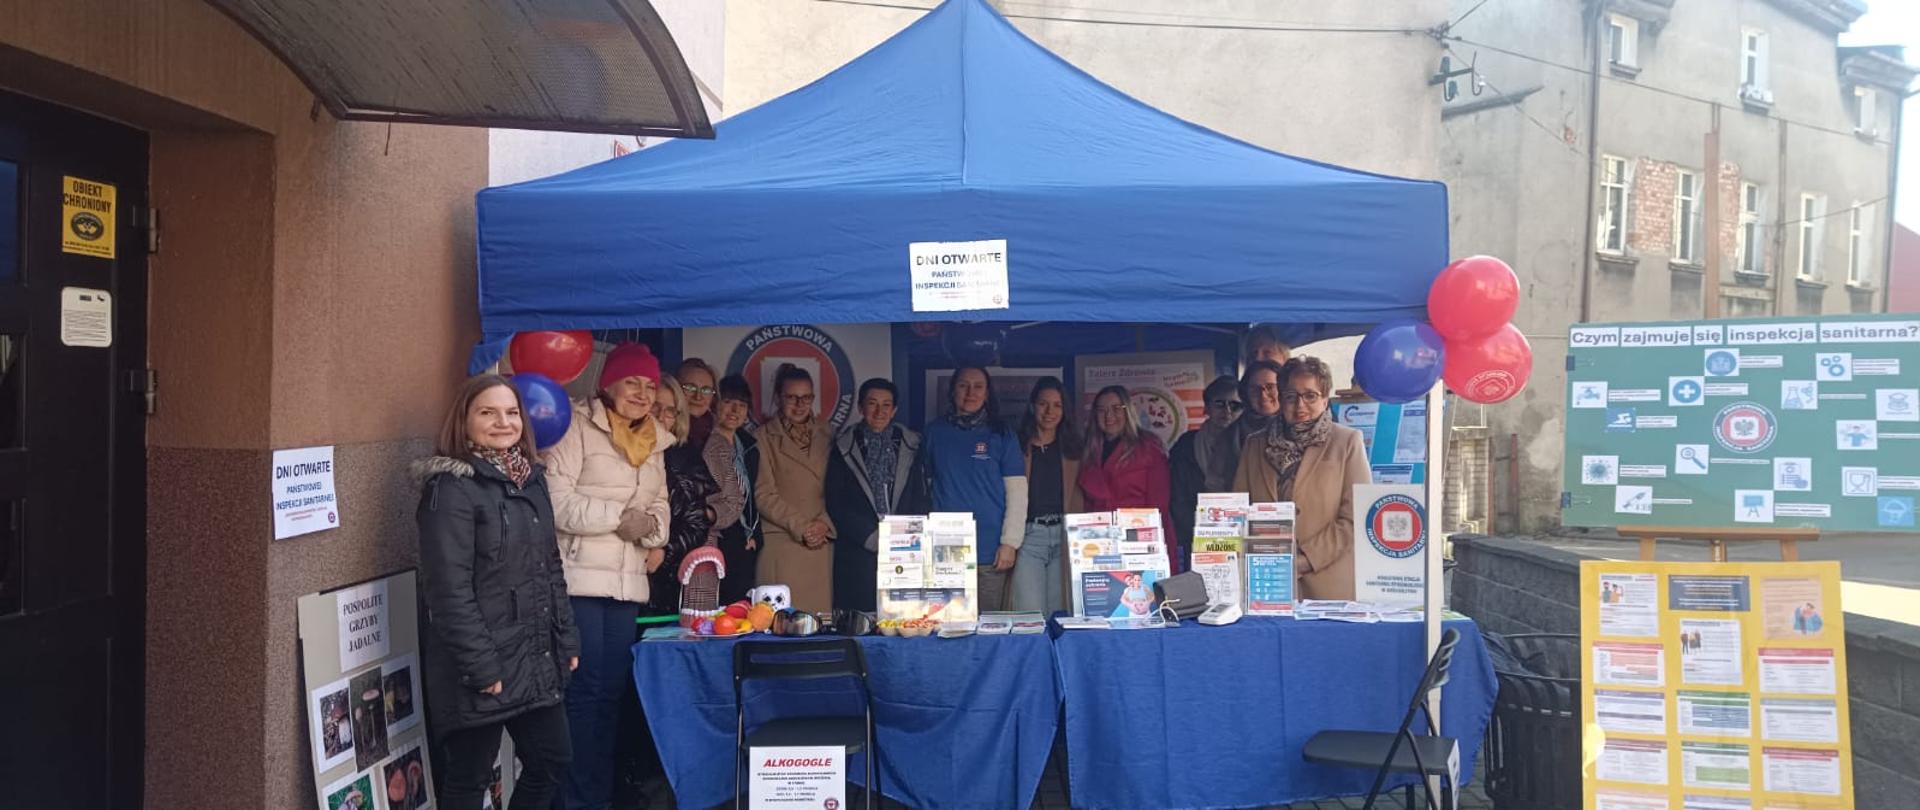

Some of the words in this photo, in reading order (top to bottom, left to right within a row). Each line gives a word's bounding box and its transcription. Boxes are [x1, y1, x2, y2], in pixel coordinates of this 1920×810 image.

[73, 180, 102, 197] OBIEKT
[64, 192, 112, 213] CHRONIONY
[916, 256, 939, 266] DNI
[941, 252, 1002, 265] OTWARTE
[746, 325, 833, 353] PAŃSTWOWA
[1572, 331, 1617, 346] Czym
[1623, 330, 1690, 345] zajmuje
[1696, 329, 1721, 342] się
[1730, 327, 1814, 342] inspekcja
[1822, 325, 1918, 339] sanitarna?
[276, 465, 292, 479] DNI
[293, 460, 331, 477] OTWARTE
[343, 594, 383, 616] POSPOLITE
[349, 614, 378, 633] GRZYBY
[349, 631, 382, 653] JADALNE
[763, 758, 832, 768] ALKOGOGLE
